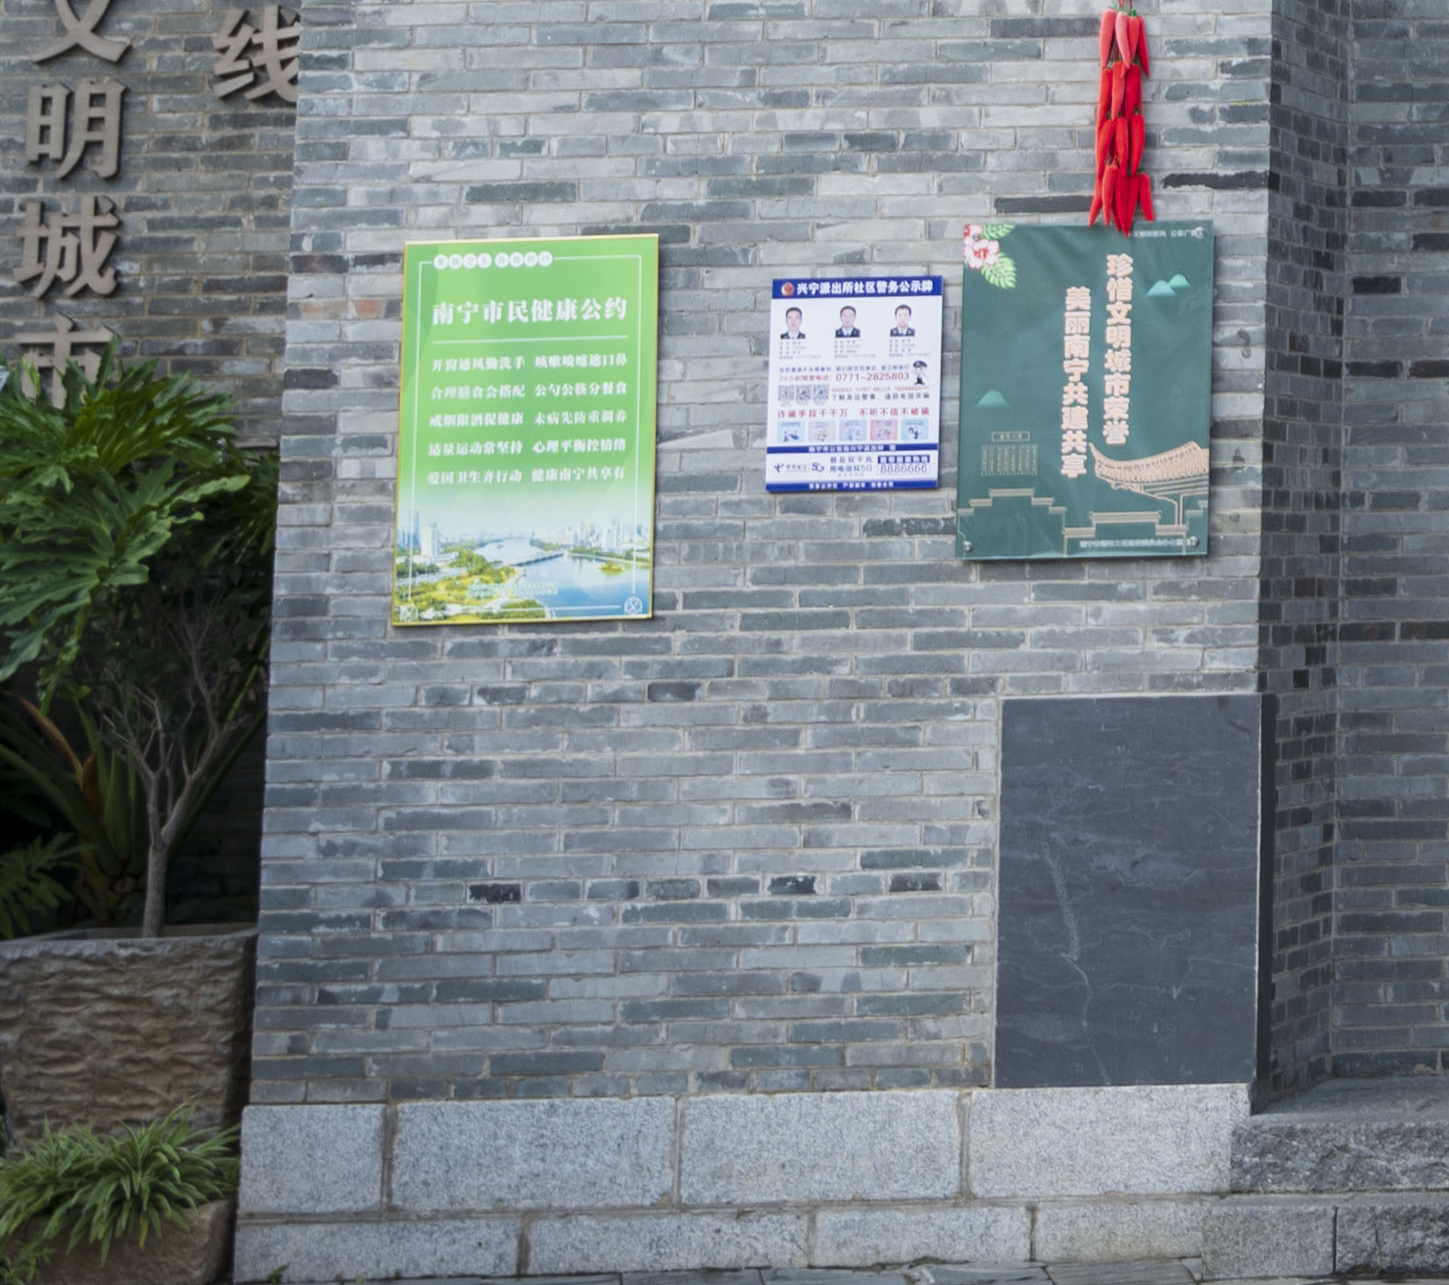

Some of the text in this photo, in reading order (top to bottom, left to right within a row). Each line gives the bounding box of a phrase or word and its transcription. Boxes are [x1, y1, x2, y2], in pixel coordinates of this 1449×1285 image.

[431, 296, 627, 326] 南宁市民健康公约
[1103, 253, 1134, 445] 珍惜文明城市荣誉
[431, 352, 628, 372] 开窗通风勤洗手 咳嗽喷嚏遮口鼻
[431, 381, 627, 400] 合理膳食会搭配 公勺公筷分餐食
[1061, 286, 1091, 478] 美丽南宁共建共享
[429, 408, 627, 428] 戒烟限酒促健康 未病先防重调养
[428, 437, 627, 457] 适量运动常坚持 心理平衡控情绪
[427, 465, 625, 486] 爱国卫生齐行动 健康南宁共享有
